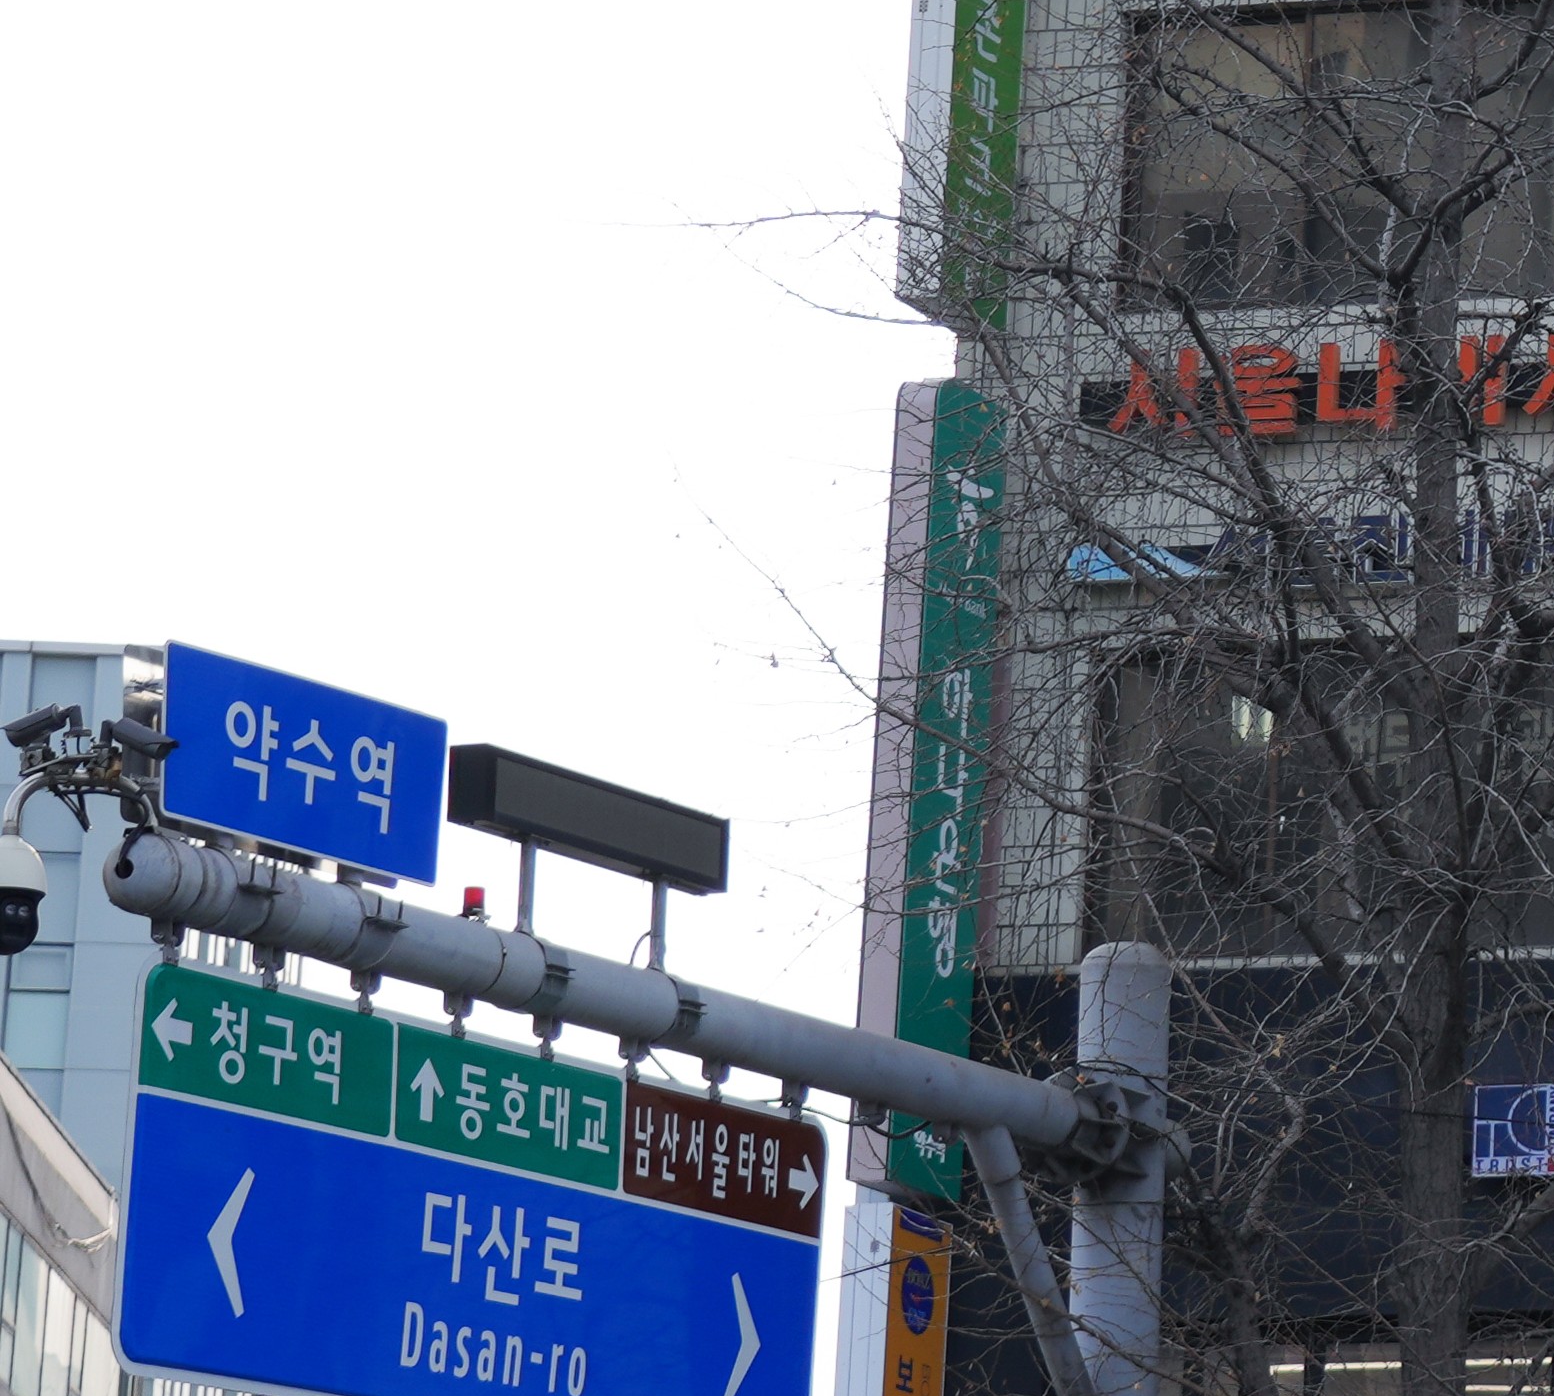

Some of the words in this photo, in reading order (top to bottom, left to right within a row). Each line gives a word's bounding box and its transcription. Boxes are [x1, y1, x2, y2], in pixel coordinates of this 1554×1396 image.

[225, 700, 395, 834] 약수역
[929, 666, 975, 980] 하나은행
[210, 1000, 343, 1106] 청구역
[456, 1063, 611, 1156] 동호대교
[634, 1106, 780, 1200] 남산서울타워
[421, 1192, 584, 1307] 다산로
